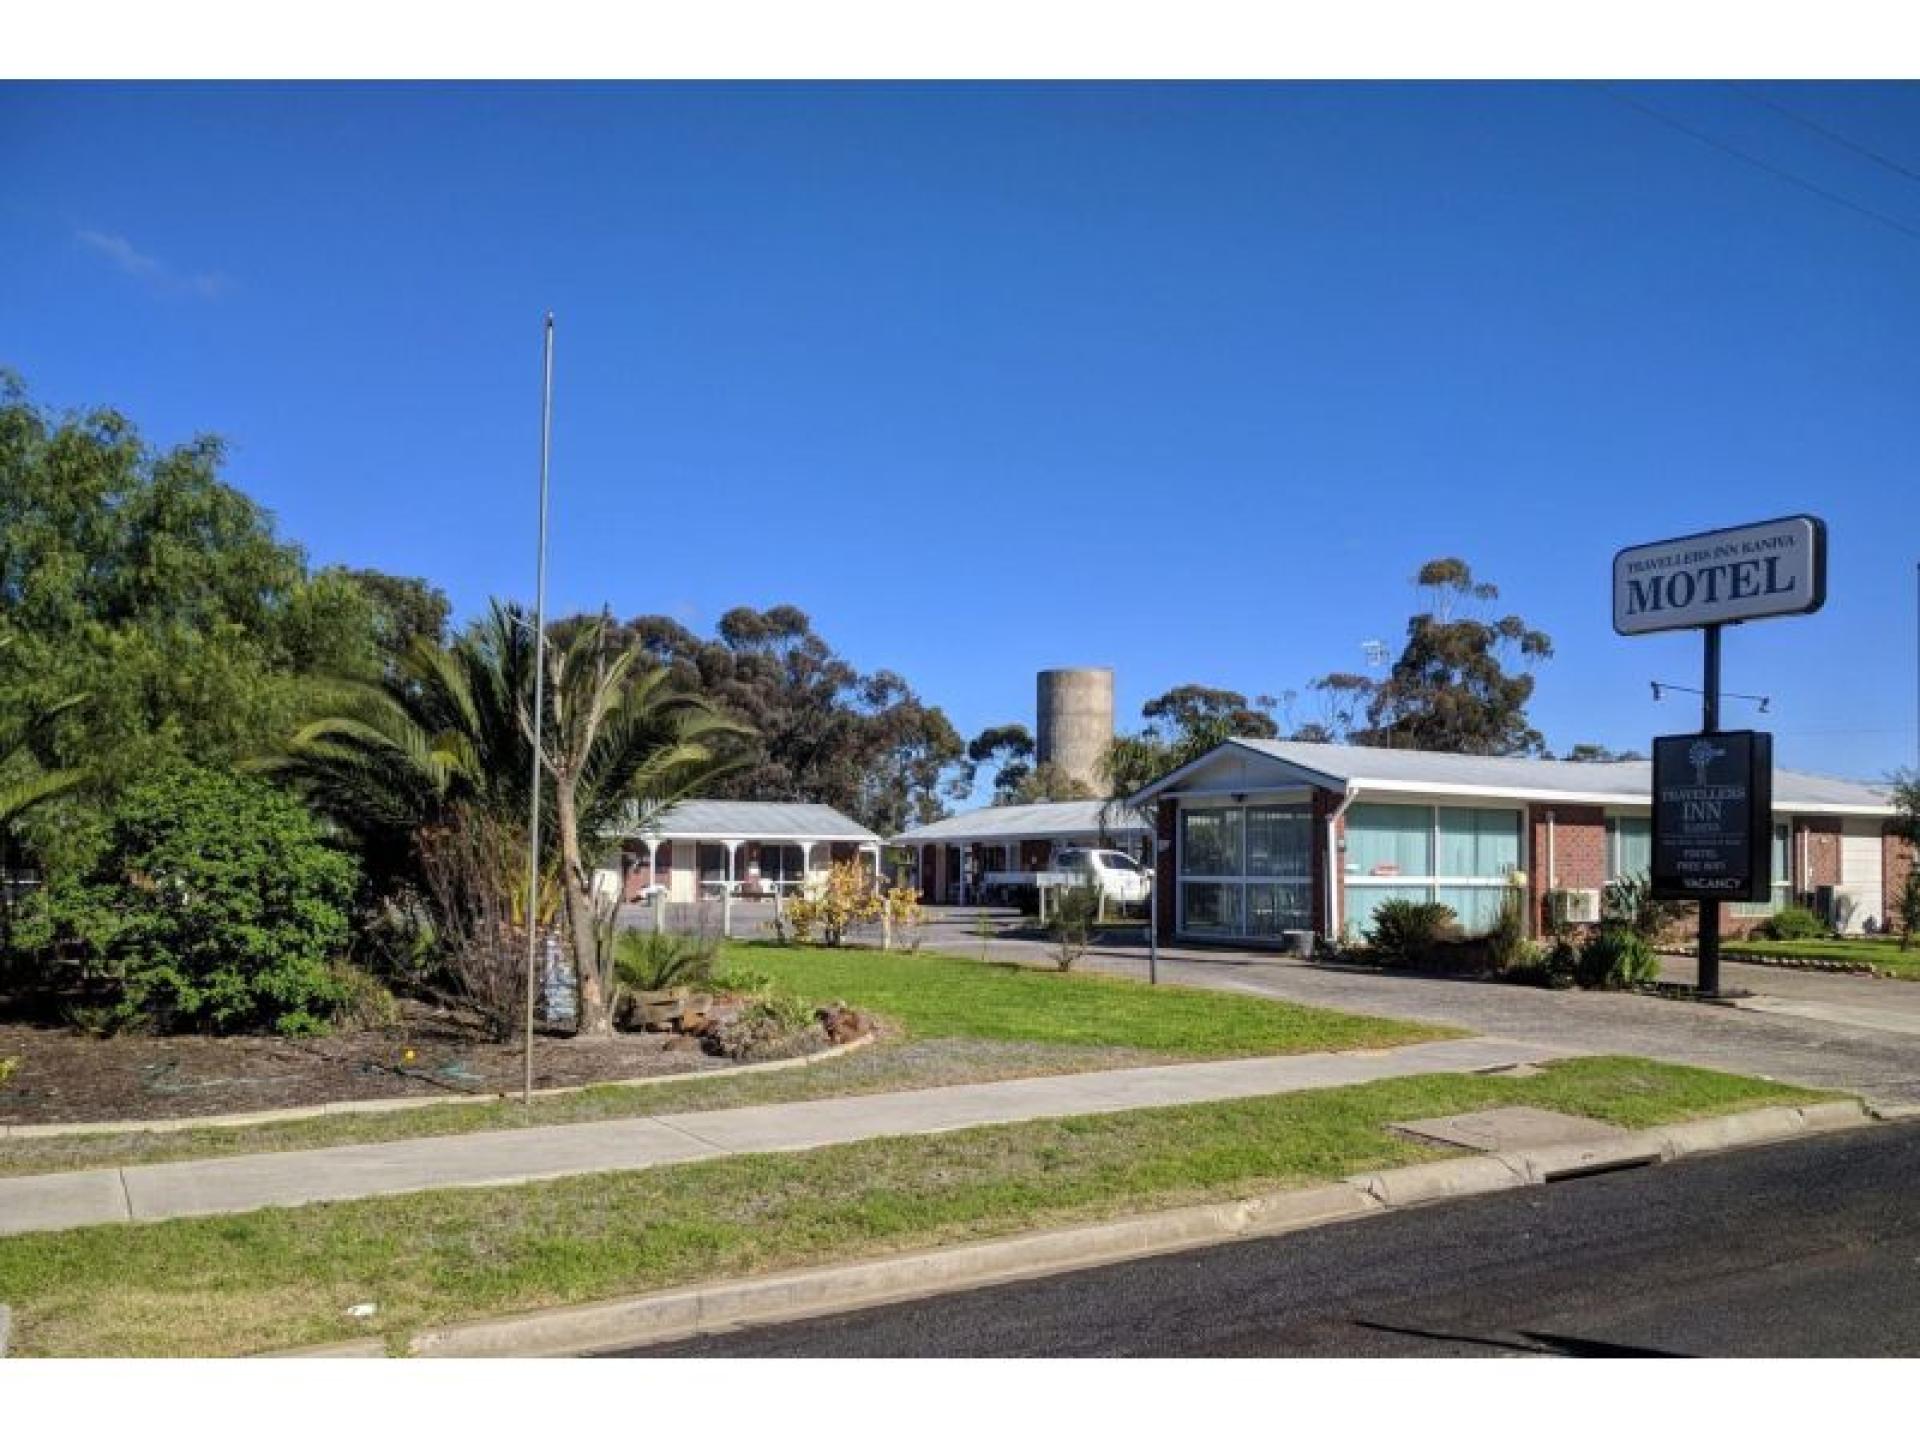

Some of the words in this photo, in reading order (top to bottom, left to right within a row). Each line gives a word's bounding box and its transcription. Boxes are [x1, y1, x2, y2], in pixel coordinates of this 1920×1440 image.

[1713, 543, 1739, 559] INN
[1625, 556, 1796, 615] MOTEL
[1683, 801, 1722, 820] INN
[1684, 878, 1742, 889] VACANCY
